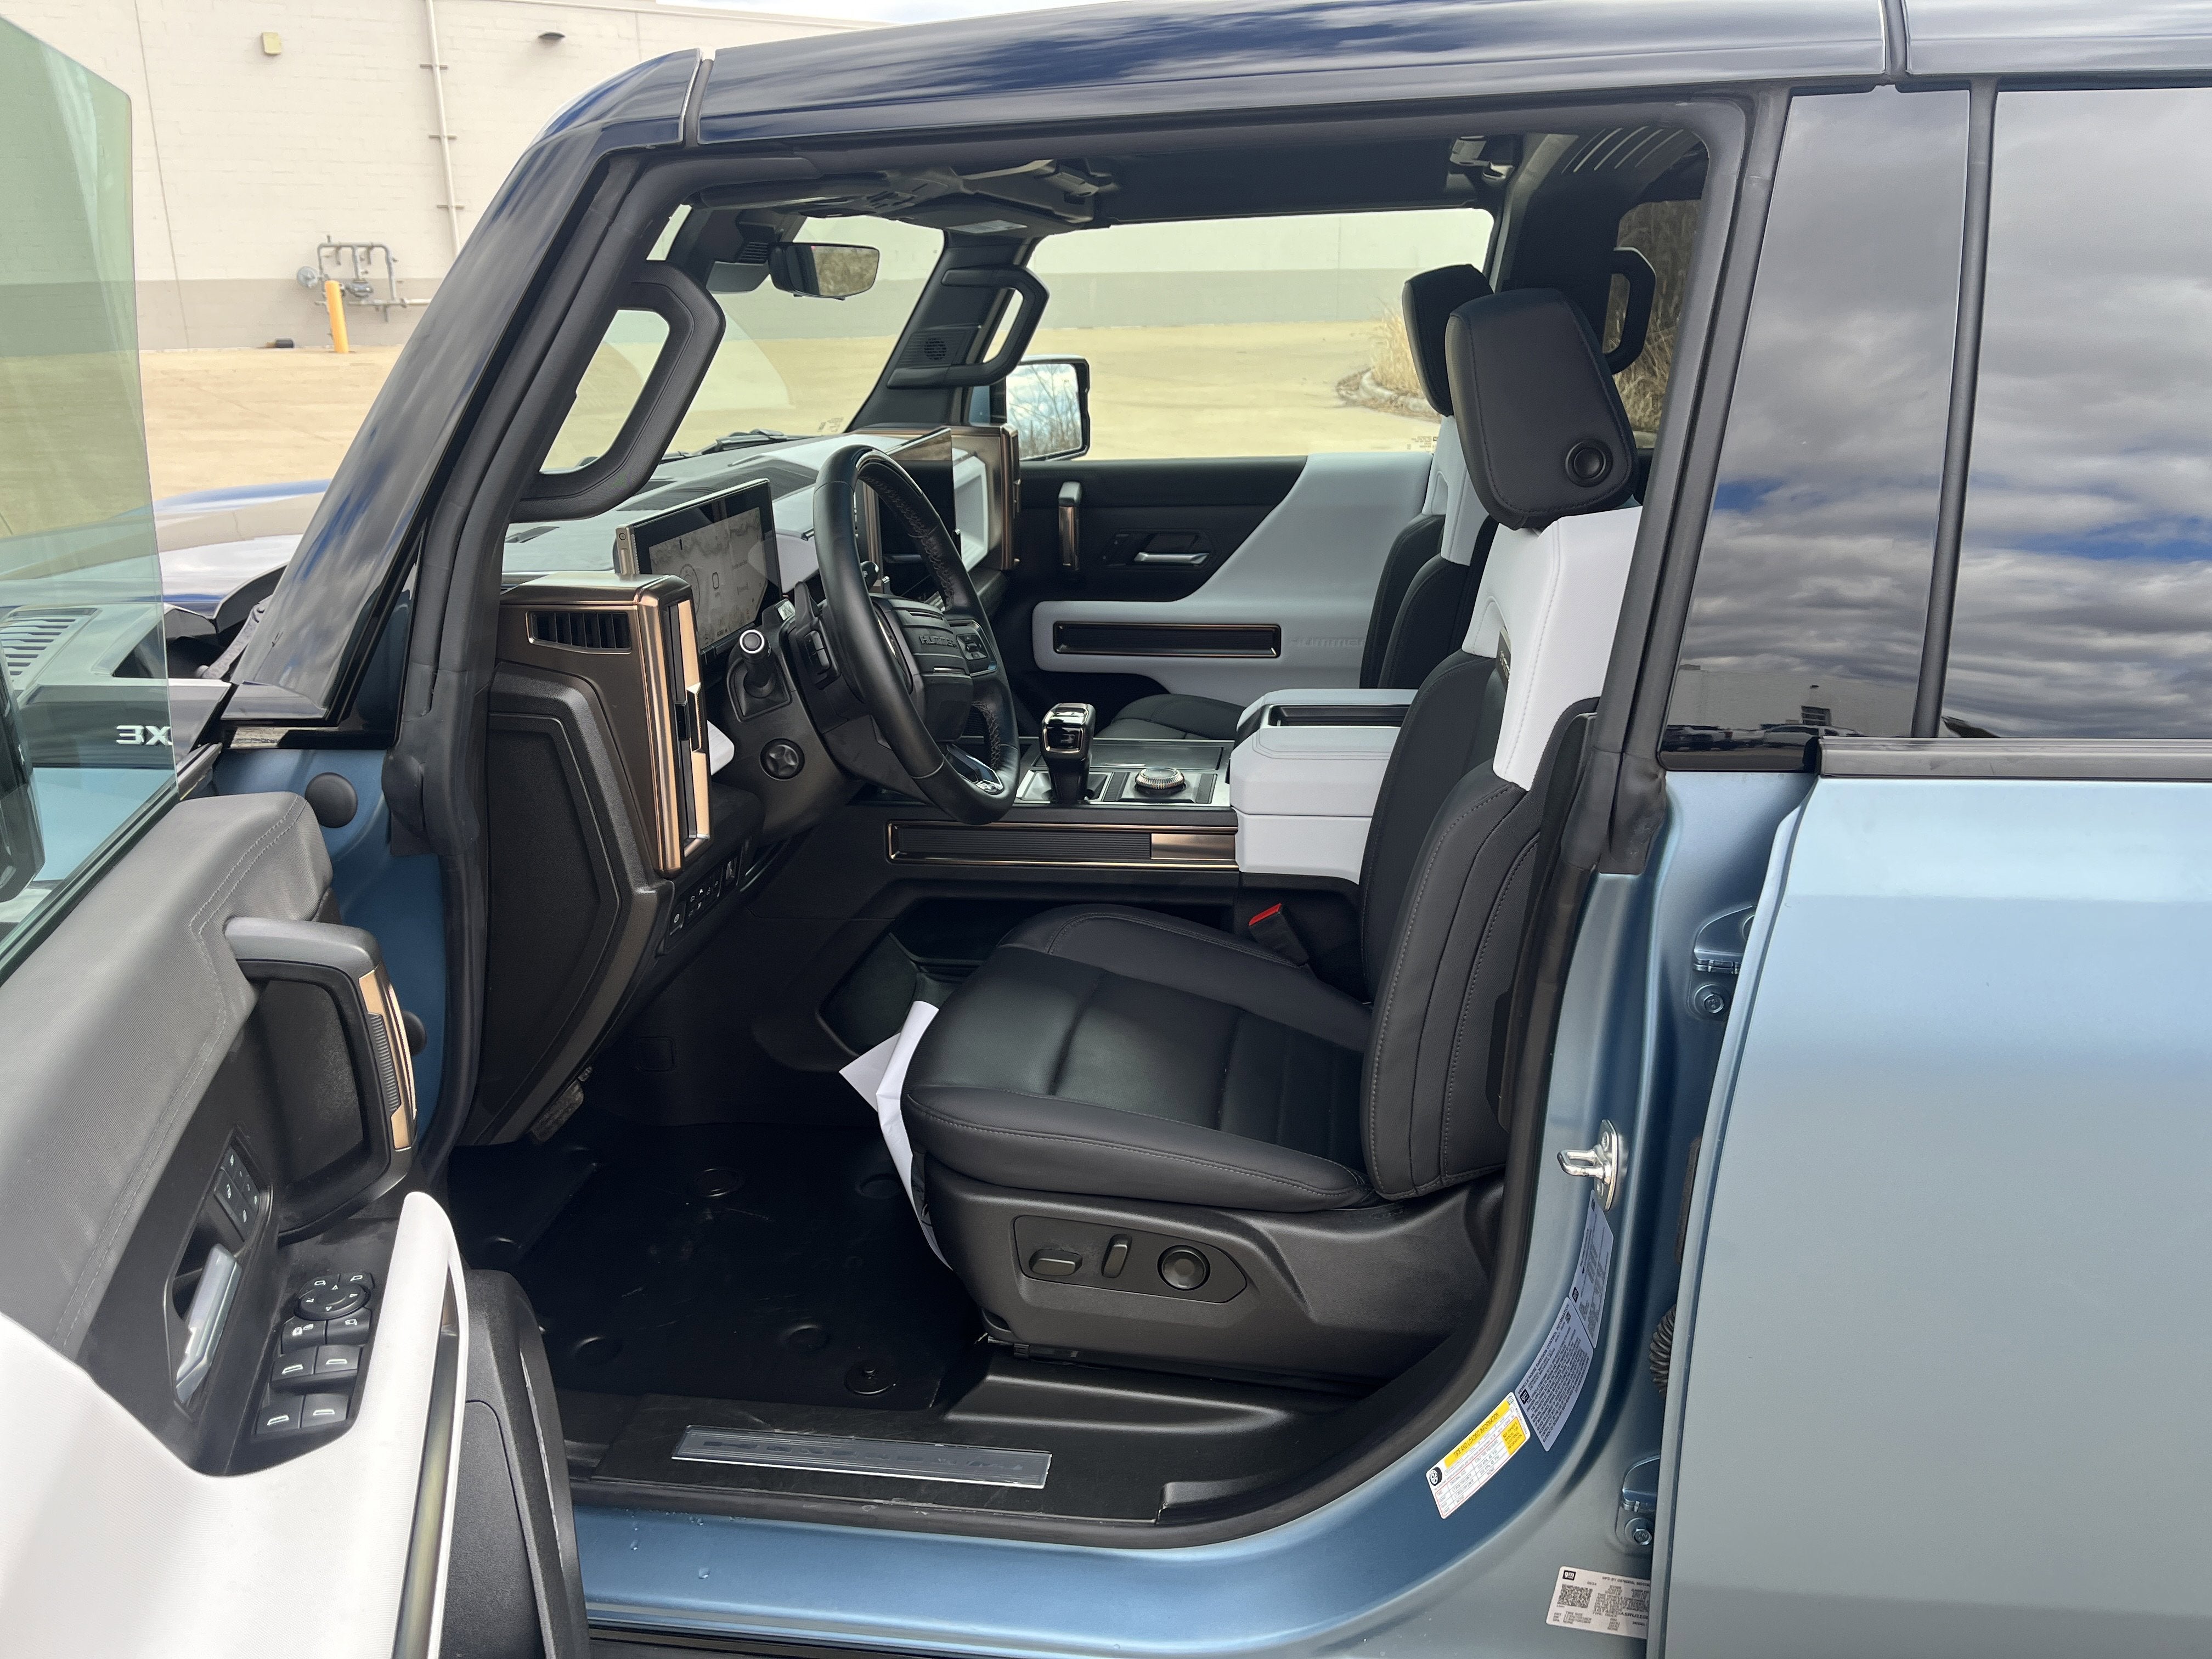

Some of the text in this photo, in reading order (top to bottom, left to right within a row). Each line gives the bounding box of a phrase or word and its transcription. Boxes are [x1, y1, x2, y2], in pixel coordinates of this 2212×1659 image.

[712, 572, 719, 590] 0
[116, 725, 173, 746] 3X
[1517, 1376, 1529, 1397] VEHICLE
[1536, 1347, 1547, 1368] EMISSION
[1546, 1330, 1556, 1350] CONTROL
[1555, 1303, 1570, 1331] INFORMATION
[1521, 1389, 1527, 1402] gm
[1453, 1447, 1462, 1458] TIRE
[1467, 1430, 1480, 1446] LOADING
[1479, 1411, 1499, 1434] INFORMATION
